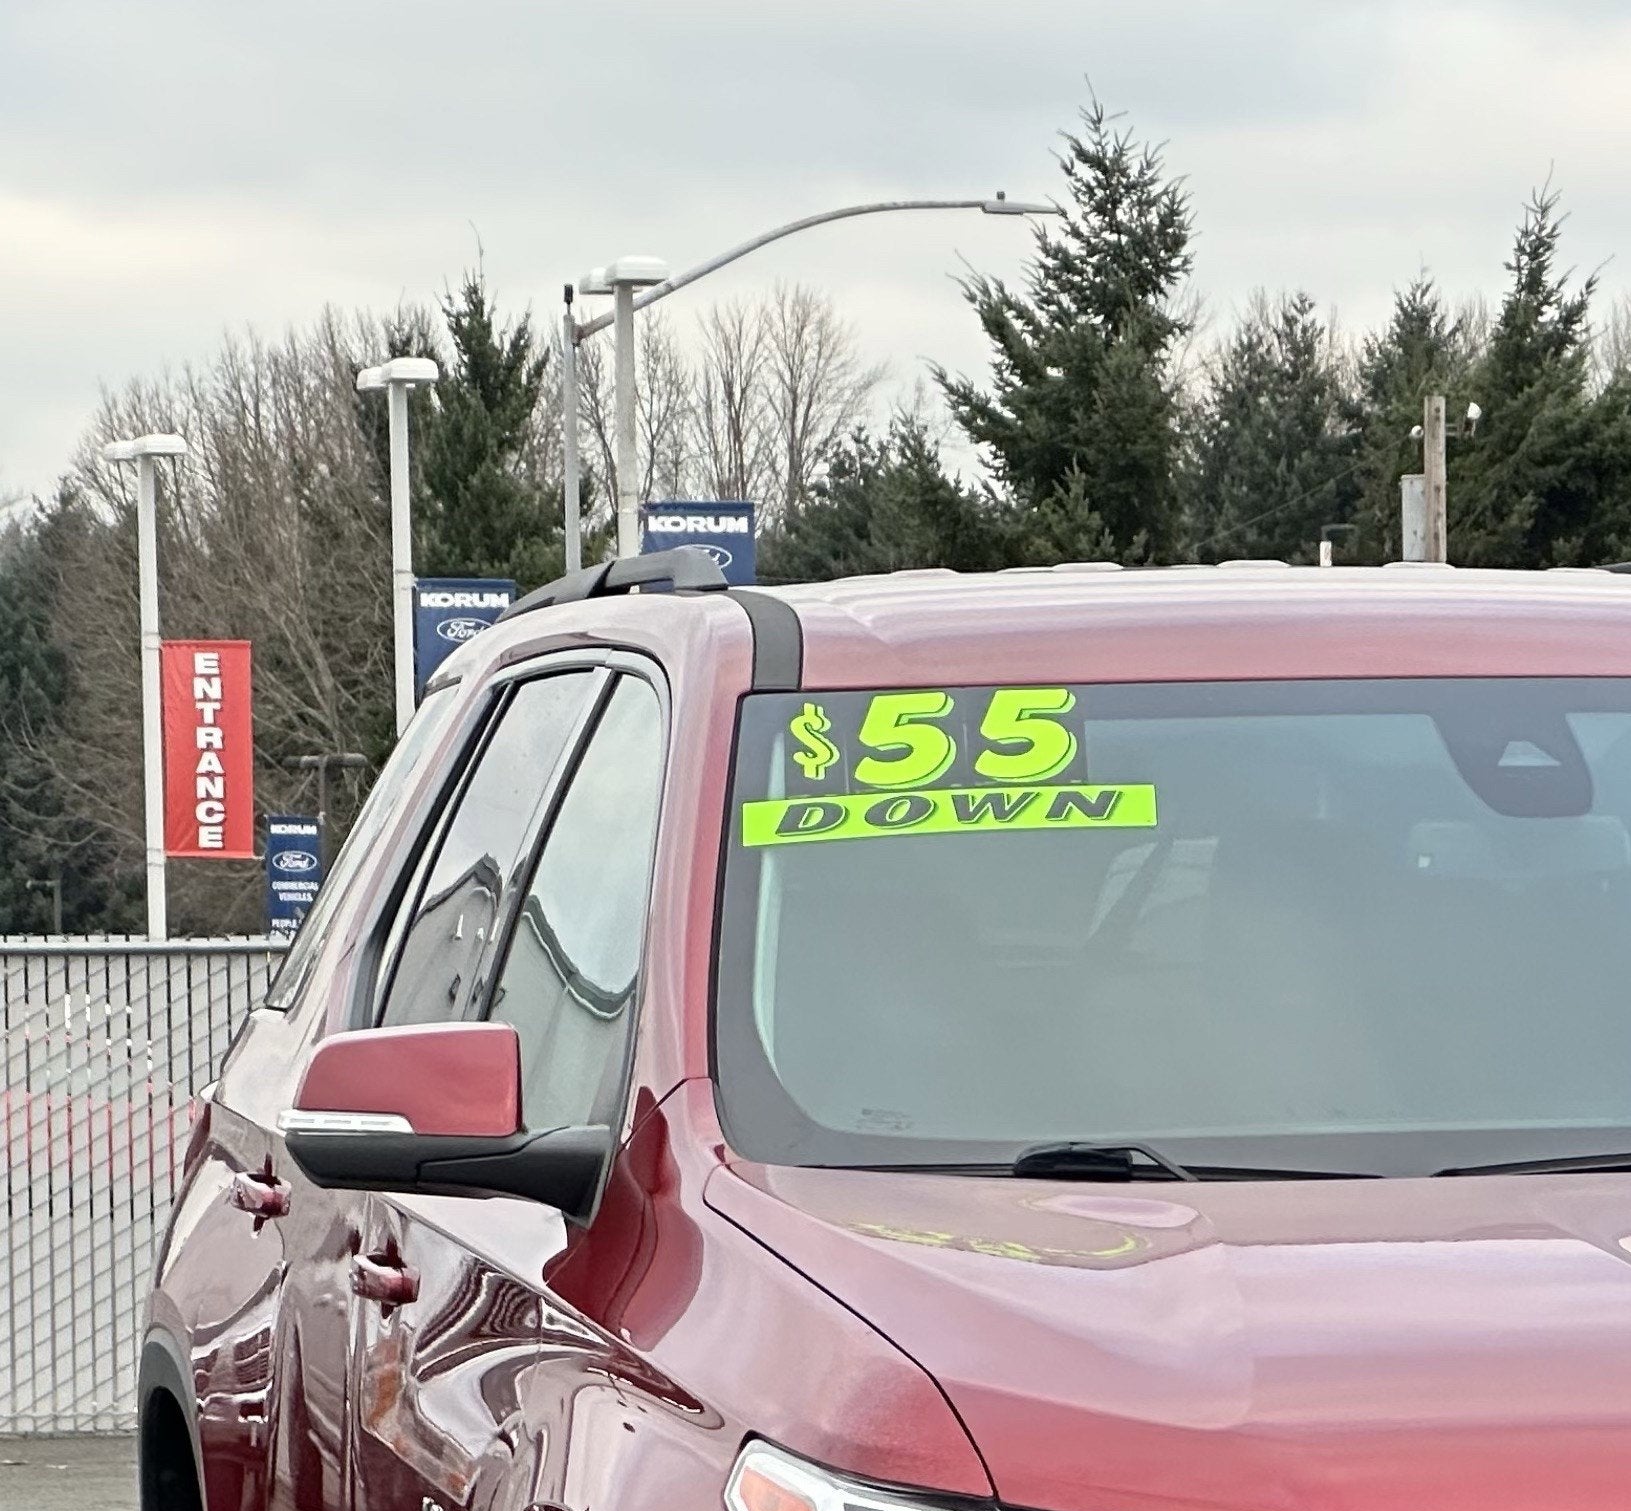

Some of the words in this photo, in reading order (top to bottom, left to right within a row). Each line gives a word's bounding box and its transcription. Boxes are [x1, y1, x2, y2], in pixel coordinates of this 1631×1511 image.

[648, 515, 748, 533] KORUM
[420, 593, 510, 608] KORUM
[193, 652, 226, 849] ENTRANCE
[775, 790, 1122, 837] DOWN
[270, 824, 317, 835] KORUM
